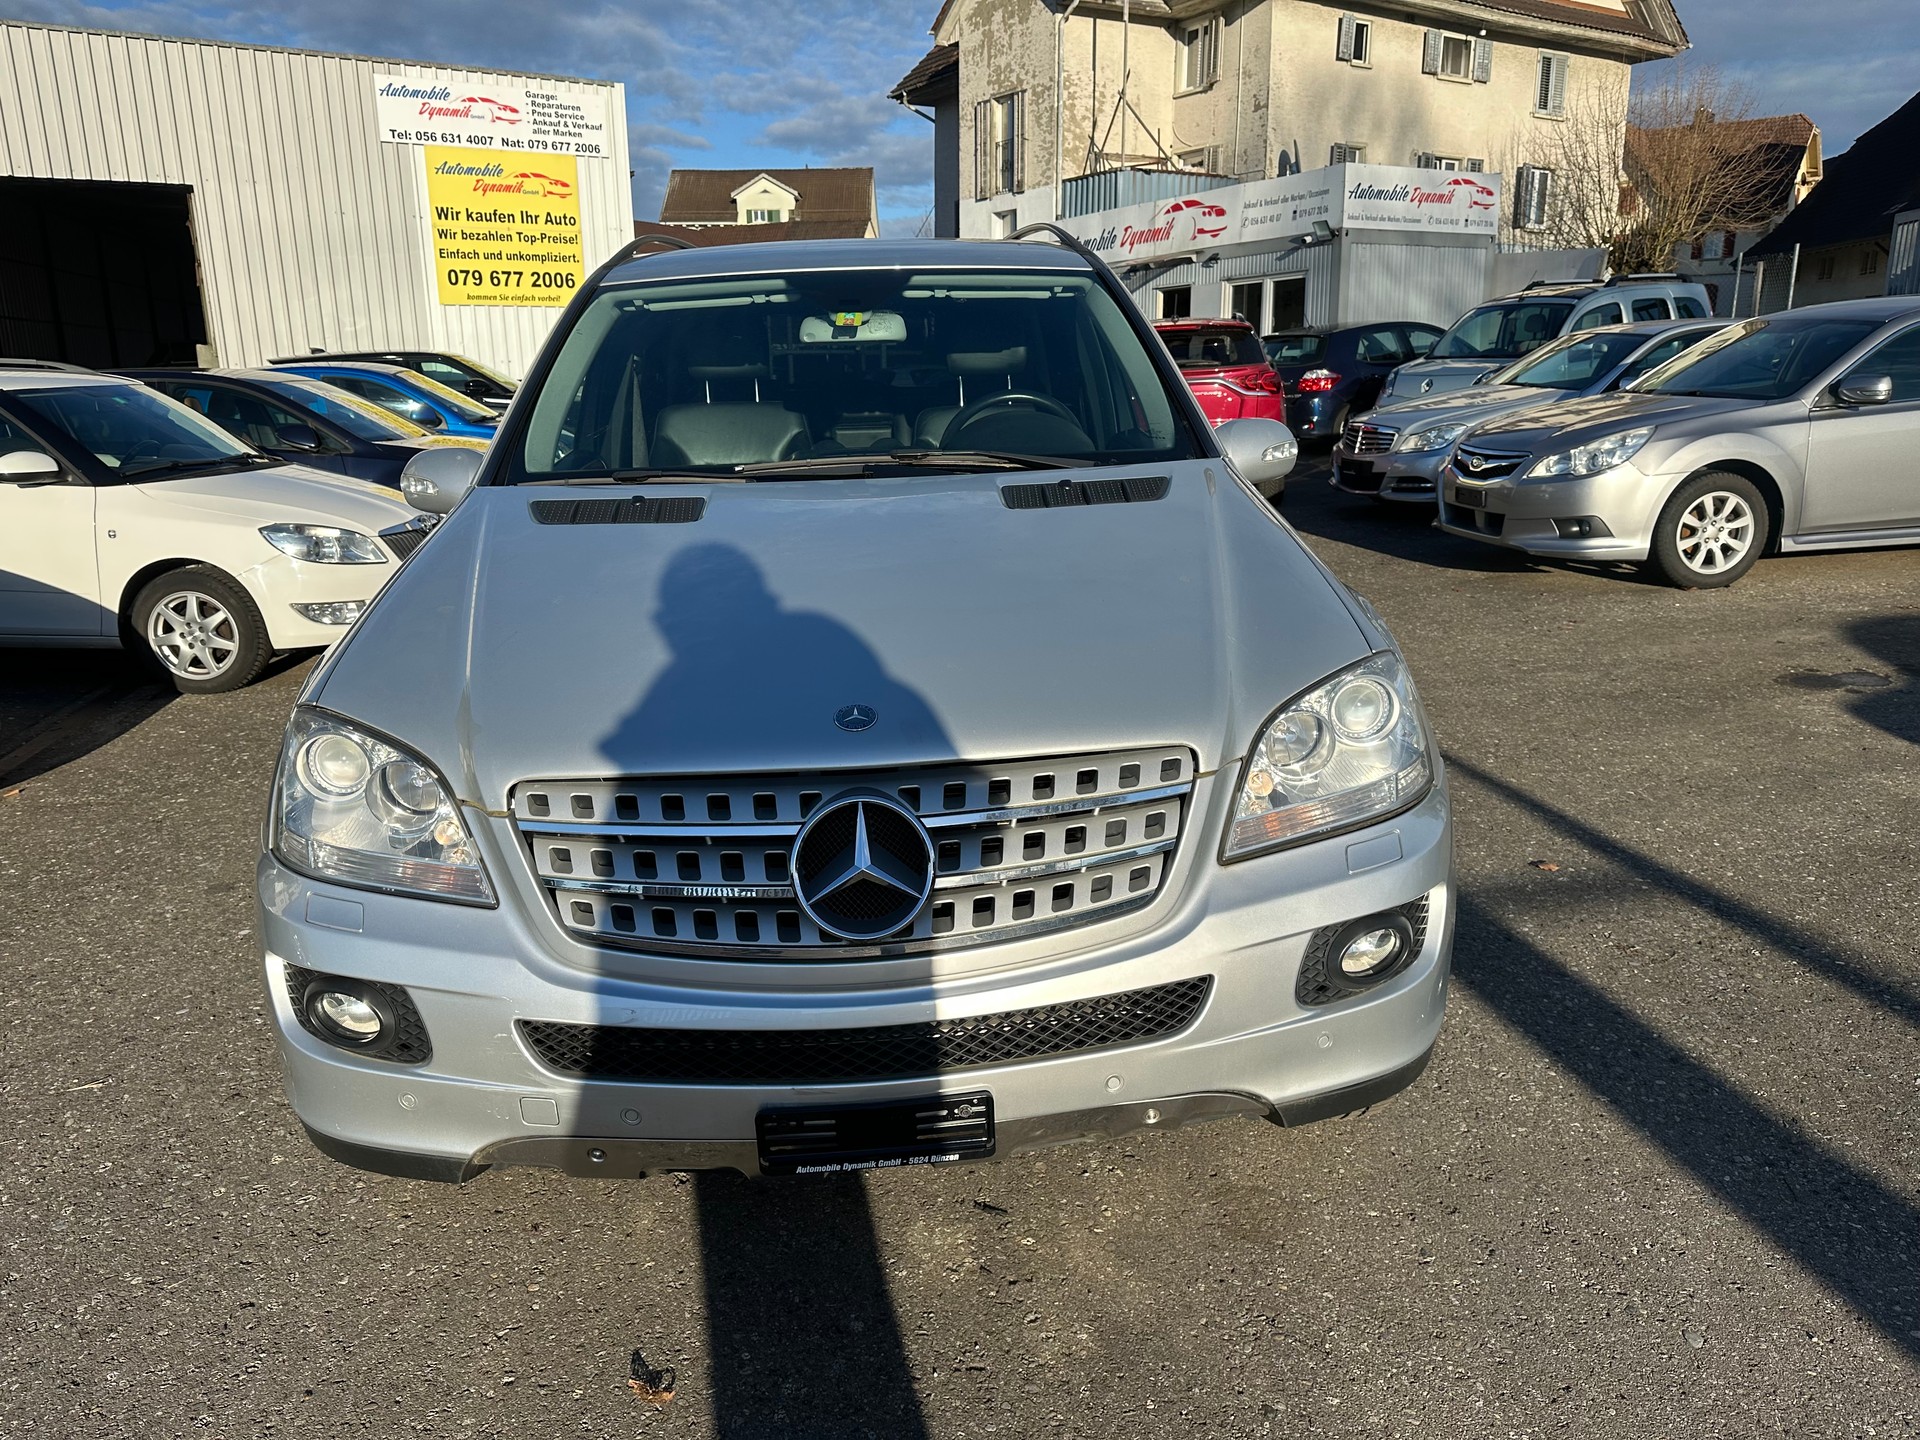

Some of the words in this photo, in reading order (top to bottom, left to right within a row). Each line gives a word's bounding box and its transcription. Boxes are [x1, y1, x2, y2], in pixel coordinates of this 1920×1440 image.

[379, 83, 450, 100] Automobile
[525, 91, 557, 100] Garage:
[418, 102, 472, 120] Dynamik
[531, 100, 580, 111] Reparaturen
[532, 109, 552, 118] Pneu
[555, 111, 584, 121] Service
[532, 118, 560, 127] Ankauf
[572, 122, 602, 131] Verkauf
[389, 129, 412, 140] Tel:
[415, 131, 437, 142] 056
[441, 133, 461, 143] 631
[466, 135, 494, 146] 4007
[502, 138, 524, 148] Nat:
[528, 140, 548, 150] 079
[552, 142, 570, 151] 677
[575, 143, 600, 154] 2006
[553, 129, 582, 138] Marken
[435, 161, 504, 177] Automobile
[473, 179, 524, 196] Dynamik
[1349, 182, 1409, 202] Automobile
[1410, 187, 1456, 209] Dynamik
[1244, 199, 1259, 209] Ankauf
[1264, 196, 1280, 206] Verkauf
[1281, 195, 1289, 204] aller
[435, 206, 461, 221] Wir
[466, 208, 515, 223] kaufen
[520, 210, 540, 224] Ihr
[544, 212, 576, 226] Auto
[1260, 216, 1268, 224] 631
[1299, 209, 1307, 218] 079
[1308, 207, 1316, 216] 677
[1323, 204, 1328, 214] 06
[437, 229, 457, 240] Wir
[461, 230, 512, 242] bezahlen
[516, 232, 578, 245] Top-Preise!
[1076, 226, 1117, 251] mobile
[1120, 217, 1175, 254] Dynamik
[439, 248, 480, 260] Einfach
[483, 250, 502, 260] und
[506, 251, 580, 264] unkompliziert.
[448, 269, 483, 286] 079
[490, 270, 523, 287] 677
[530, 272, 575, 288] 2006
[511, 294, 536, 303] einfach
[796, 1164, 841, 1174] Automobile
[843, 1160, 876, 1171] Dynamik
[878, 1158, 902, 1168] GmbH
[909, 1156, 929, 1165] 5624
[930, 1154, 959, 1163] Bünzen
